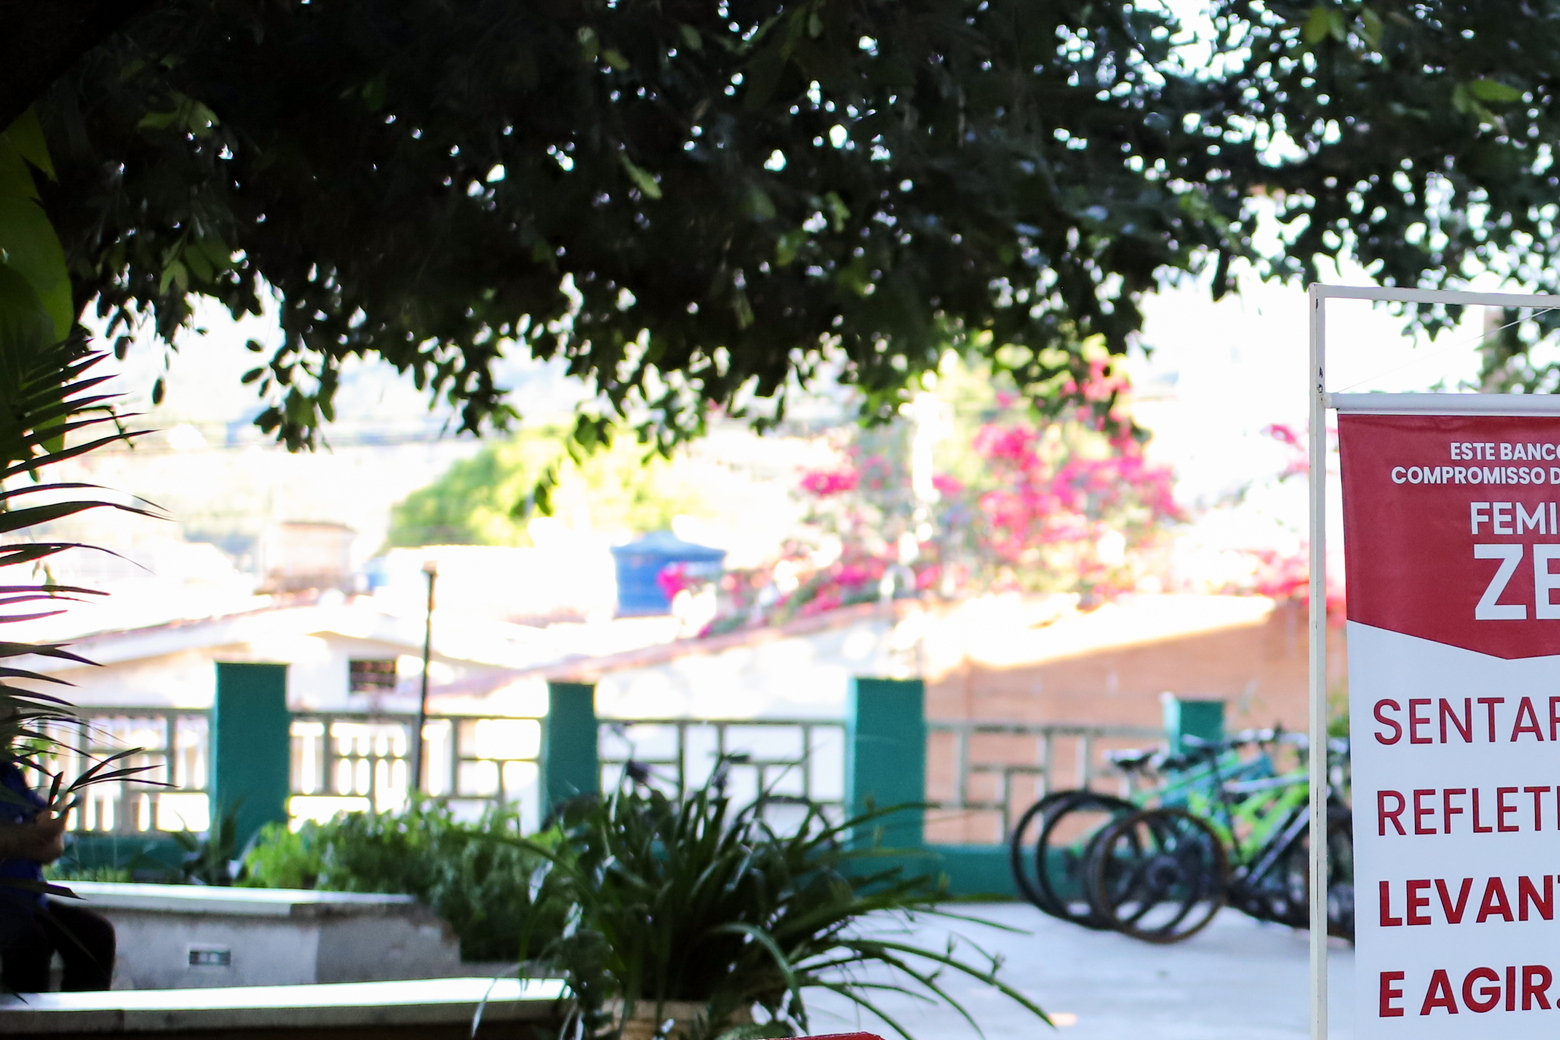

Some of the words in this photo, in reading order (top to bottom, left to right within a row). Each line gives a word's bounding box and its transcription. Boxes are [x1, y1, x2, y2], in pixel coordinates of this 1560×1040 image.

[1450, 443, 1495, 460] ESTE
[1391, 466, 1546, 484] COMPROMISSO
[1380, 970, 1404, 1018] E
